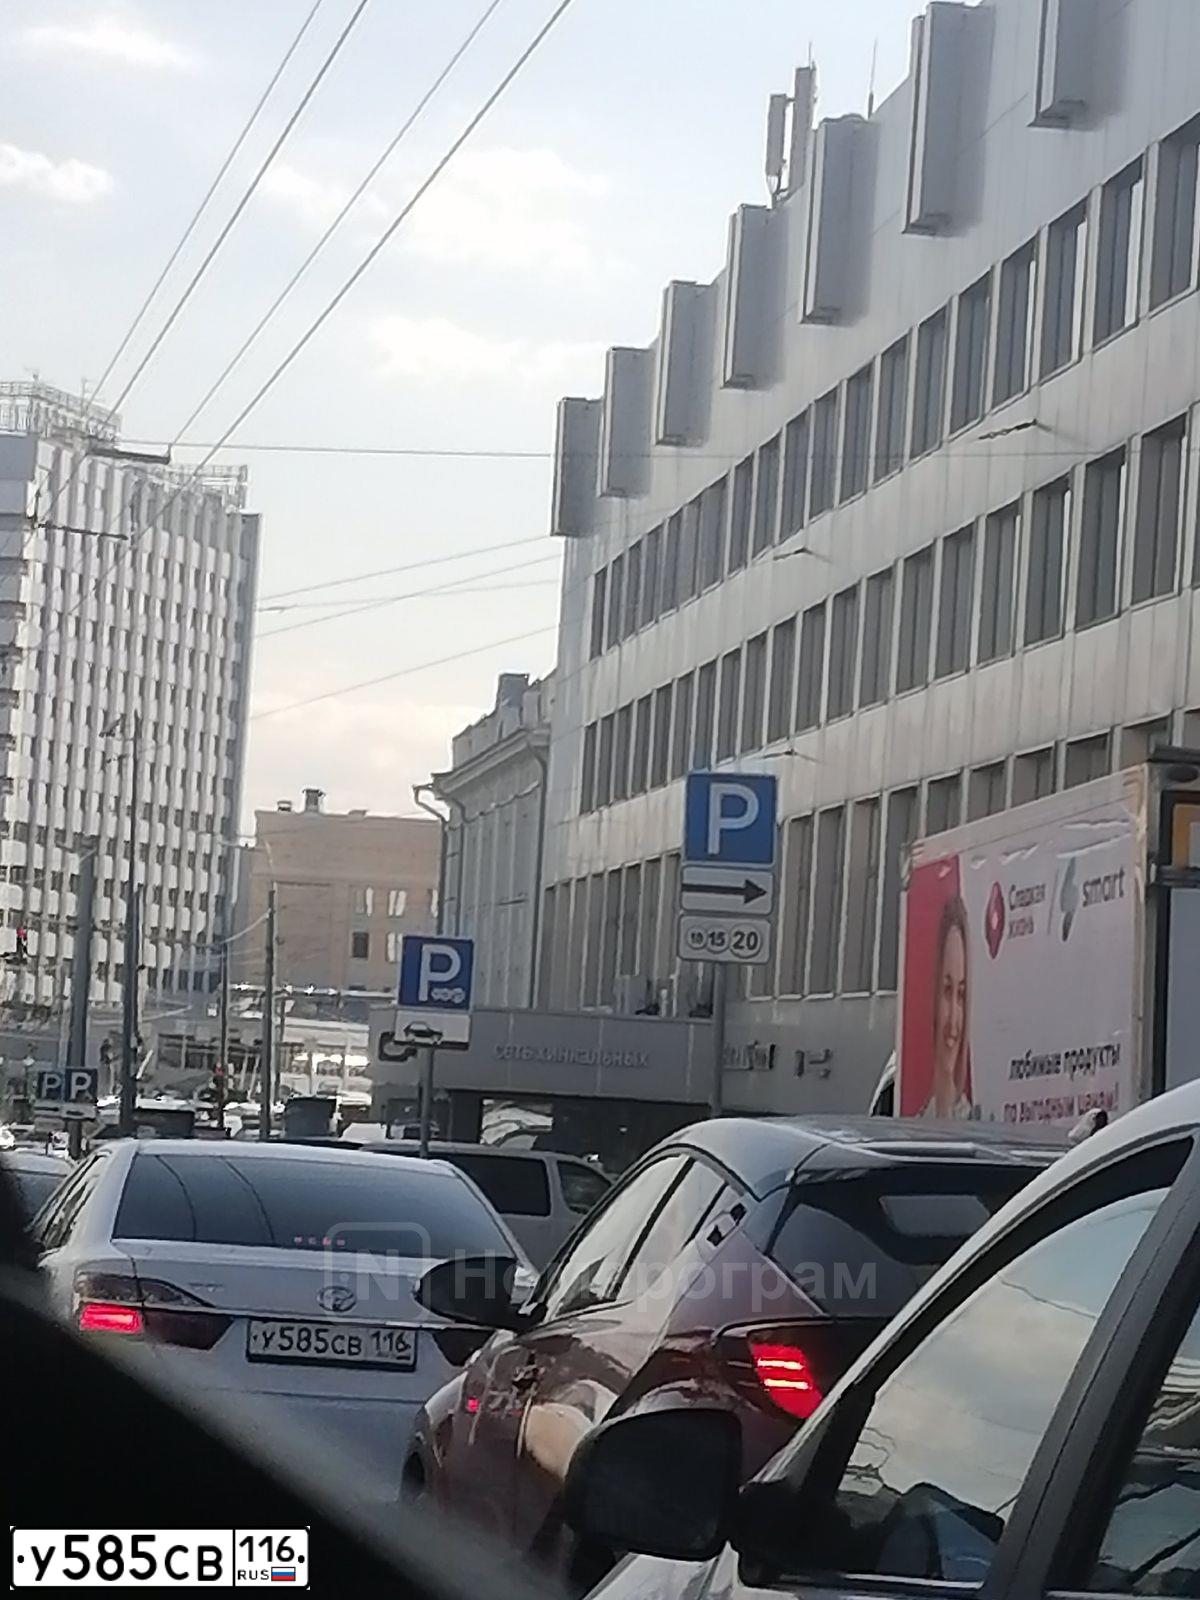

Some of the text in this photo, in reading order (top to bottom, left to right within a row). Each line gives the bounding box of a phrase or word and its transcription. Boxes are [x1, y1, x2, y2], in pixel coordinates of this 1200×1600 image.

[707, 782, 759, 855] P
[1082, 867, 1125, 908] smart
[708, 931, 726, 947] 15
[733, 930, 758, 950] 20
[418, 943, 461, 1002] P
[1063, 1043, 1121, 1081] продукты
[41, 1073, 62, 1098] P
[70, 1072, 92, 1099] P
[371, 1330, 412, 1353] 116
